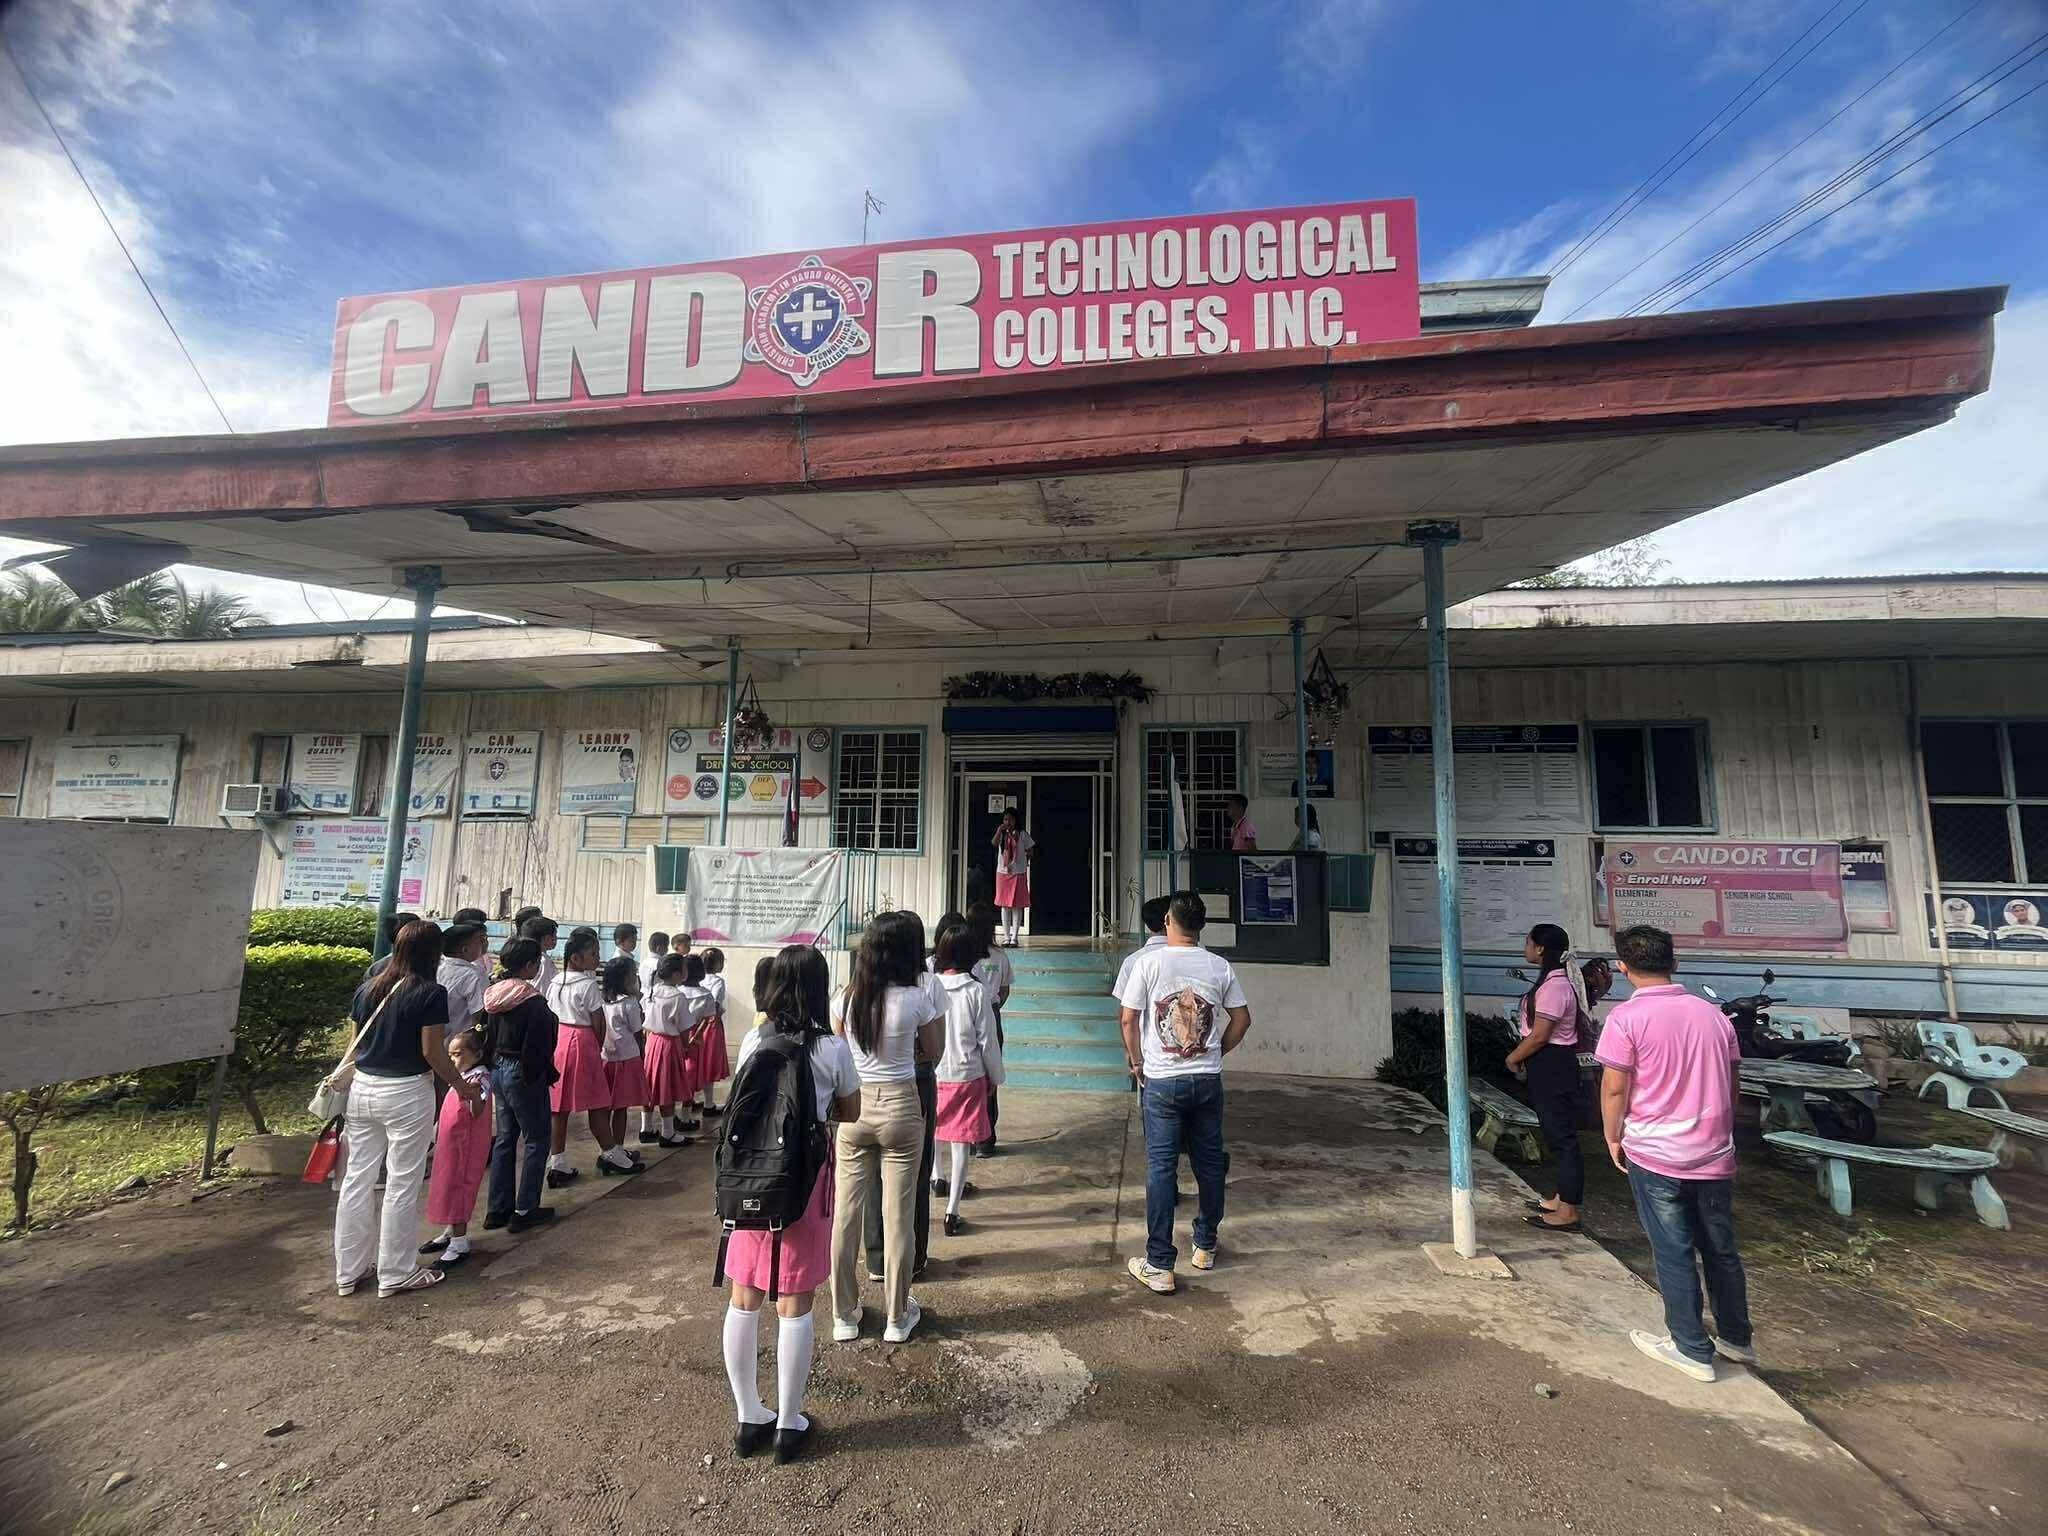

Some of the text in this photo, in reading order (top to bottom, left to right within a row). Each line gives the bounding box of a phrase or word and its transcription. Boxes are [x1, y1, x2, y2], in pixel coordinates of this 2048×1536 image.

[993, 212, 1397, 299] TECHNOLOGICAL
[758, 270, 857, 367] CHRISTIAN ACADEMY IN DAVAO ORIENTAL
[993, 286, 1358, 368] COLLEGES, INC.
[312, 735, 344, 747] YOUR
[488, 735, 515, 747] CAN
[578, 733, 630, 745] LEARN?
[307, 747, 345, 755] QUALITY
[468, 747, 534, 755] TRADITIONAL
[583, 745, 624, 753] VALUES
[749, 760, 792, 770] SCHOOL
[1653, 846, 1818, 866] CANDOR TCI
[1627, 874, 1708, 886] Enroll Now!
[1614, 889, 1658, 898] ELEMENTARY
[1724, 891, 1793, 902] SENIOR HIGH SCHOOL
